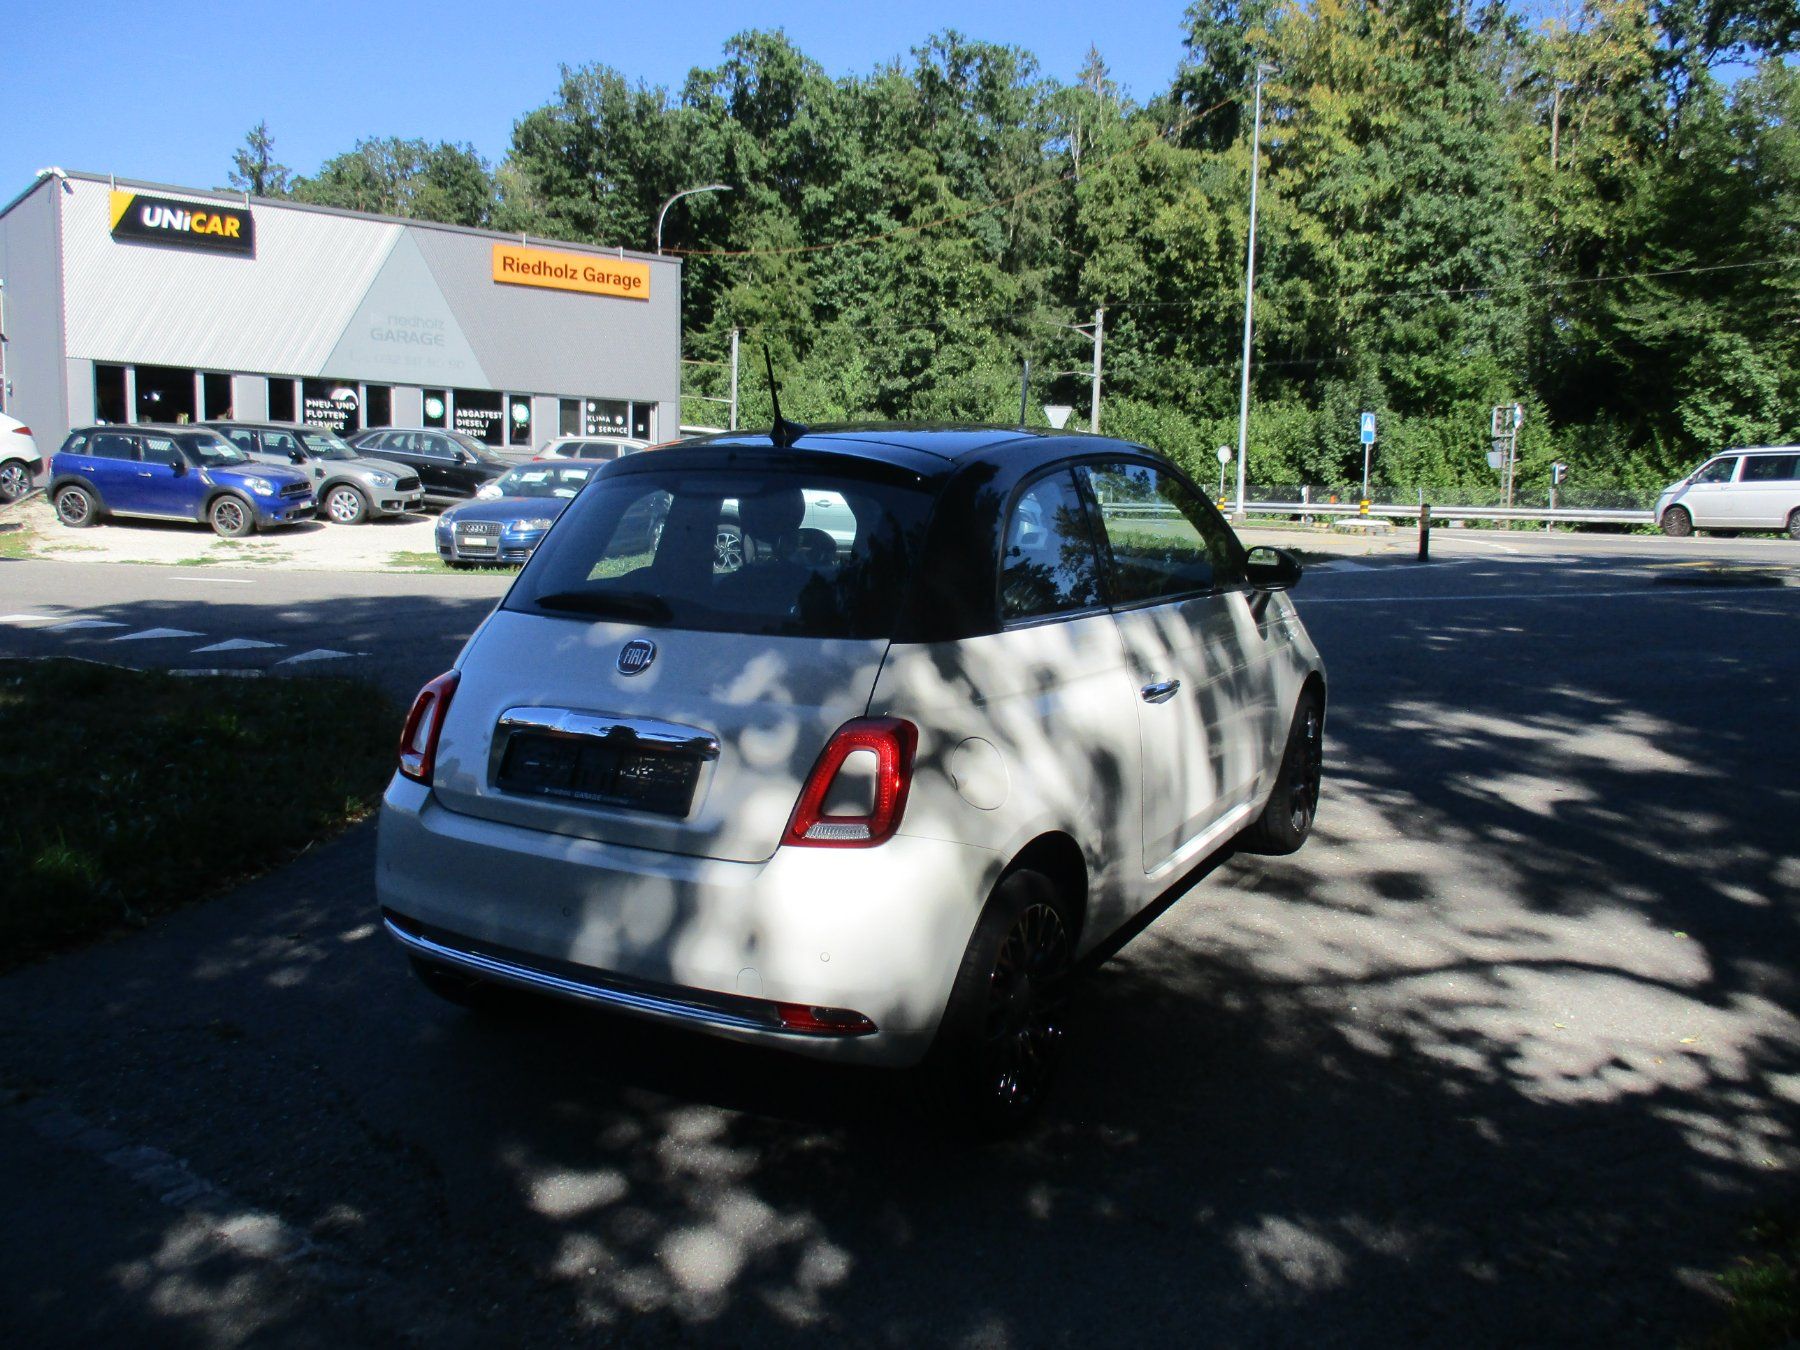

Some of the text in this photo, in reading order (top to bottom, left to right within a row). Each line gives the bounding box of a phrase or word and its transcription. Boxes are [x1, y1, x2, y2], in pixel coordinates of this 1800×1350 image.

[502, 255, 642, 291] Riedholz Garage
[370, 328, 445, 347] GARAGE
[305, 399, 356, 411] PNEU- UND
[306, 409, 349, 420] FLOTTEN-
[456, 409, 503, 420] ABGASTEST
[586, 414, 611, 424] KLIMA
[306, 420, 345, 430] SERVICE
[456, 419, 484, 429] DIESEL
[598, 425, 628, 434] SERVICE
[623, 648, 647, 665] FIAT
